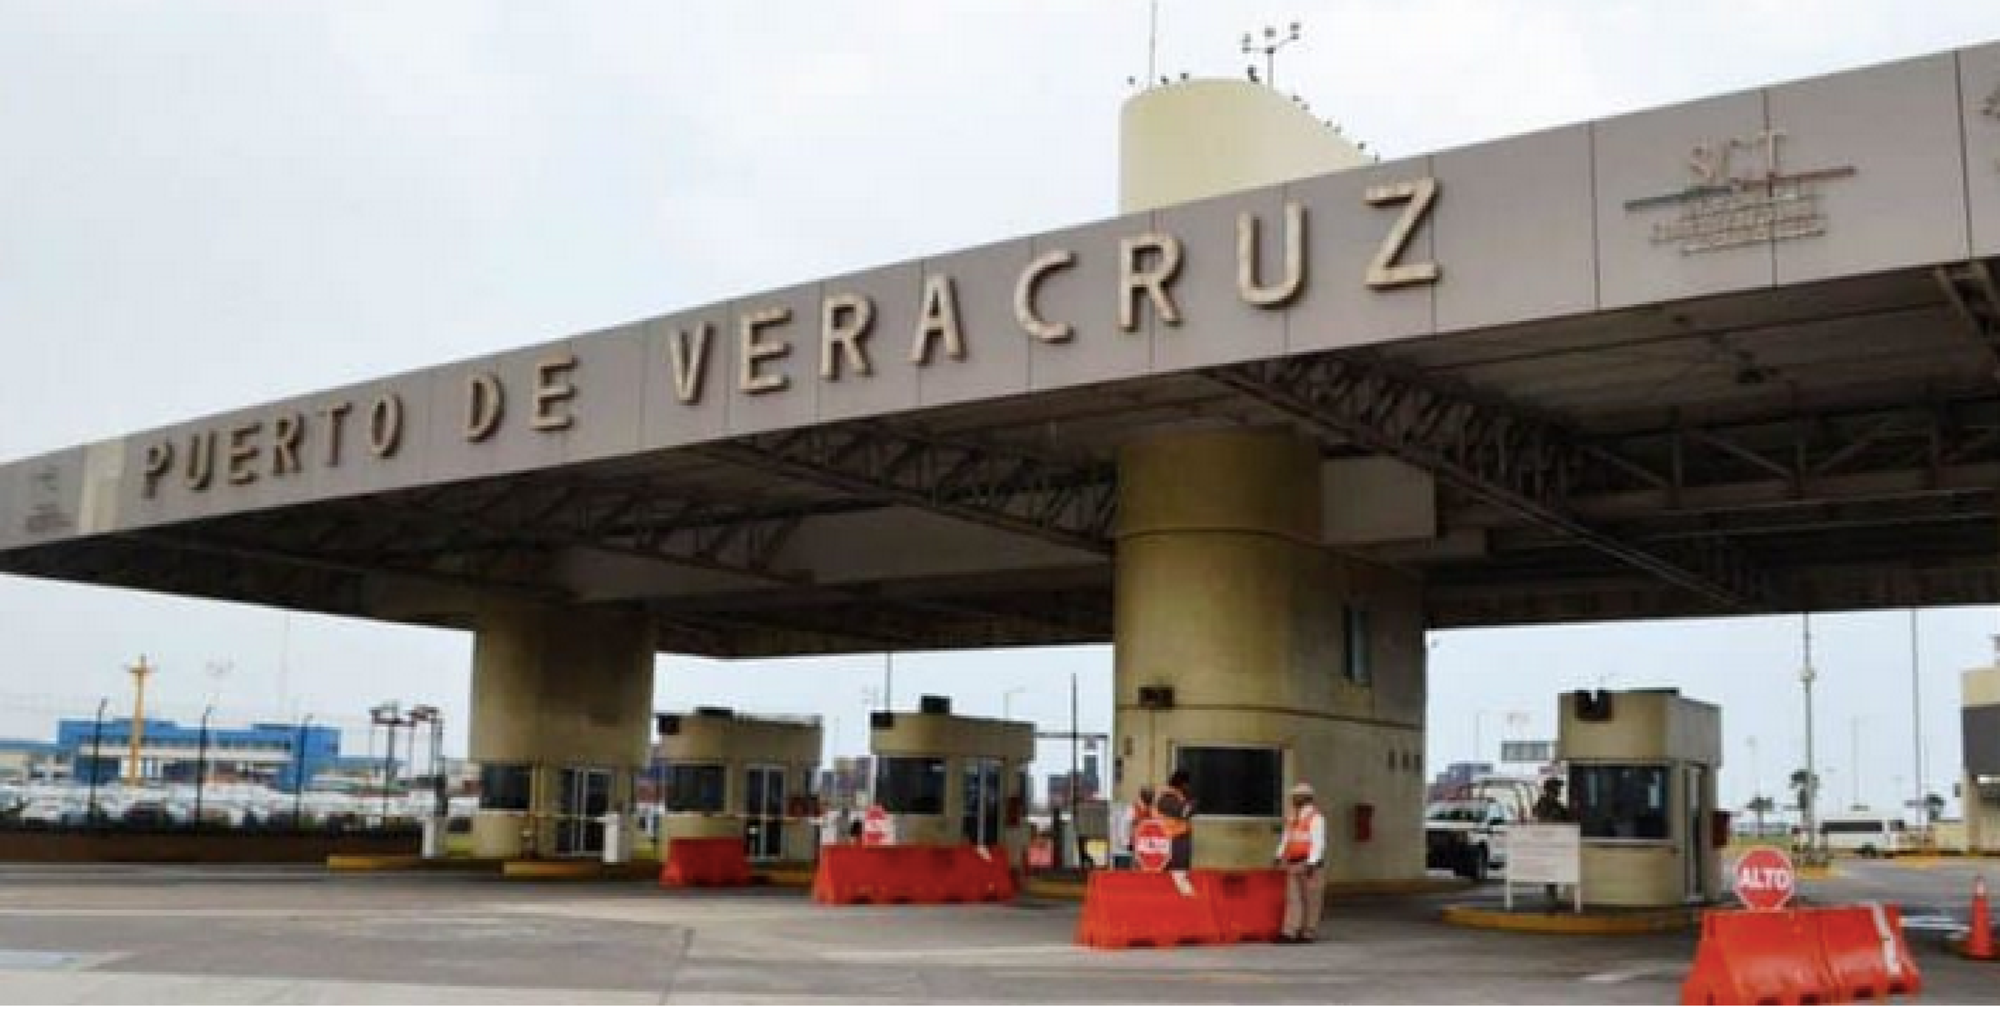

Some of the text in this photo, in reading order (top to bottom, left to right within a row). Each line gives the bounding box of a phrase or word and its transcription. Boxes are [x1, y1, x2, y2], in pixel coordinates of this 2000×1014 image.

[140, 176, 1443, 500] PUERTO DE VERACRUZ
[1738, 866, 1791, 890] ALTO
